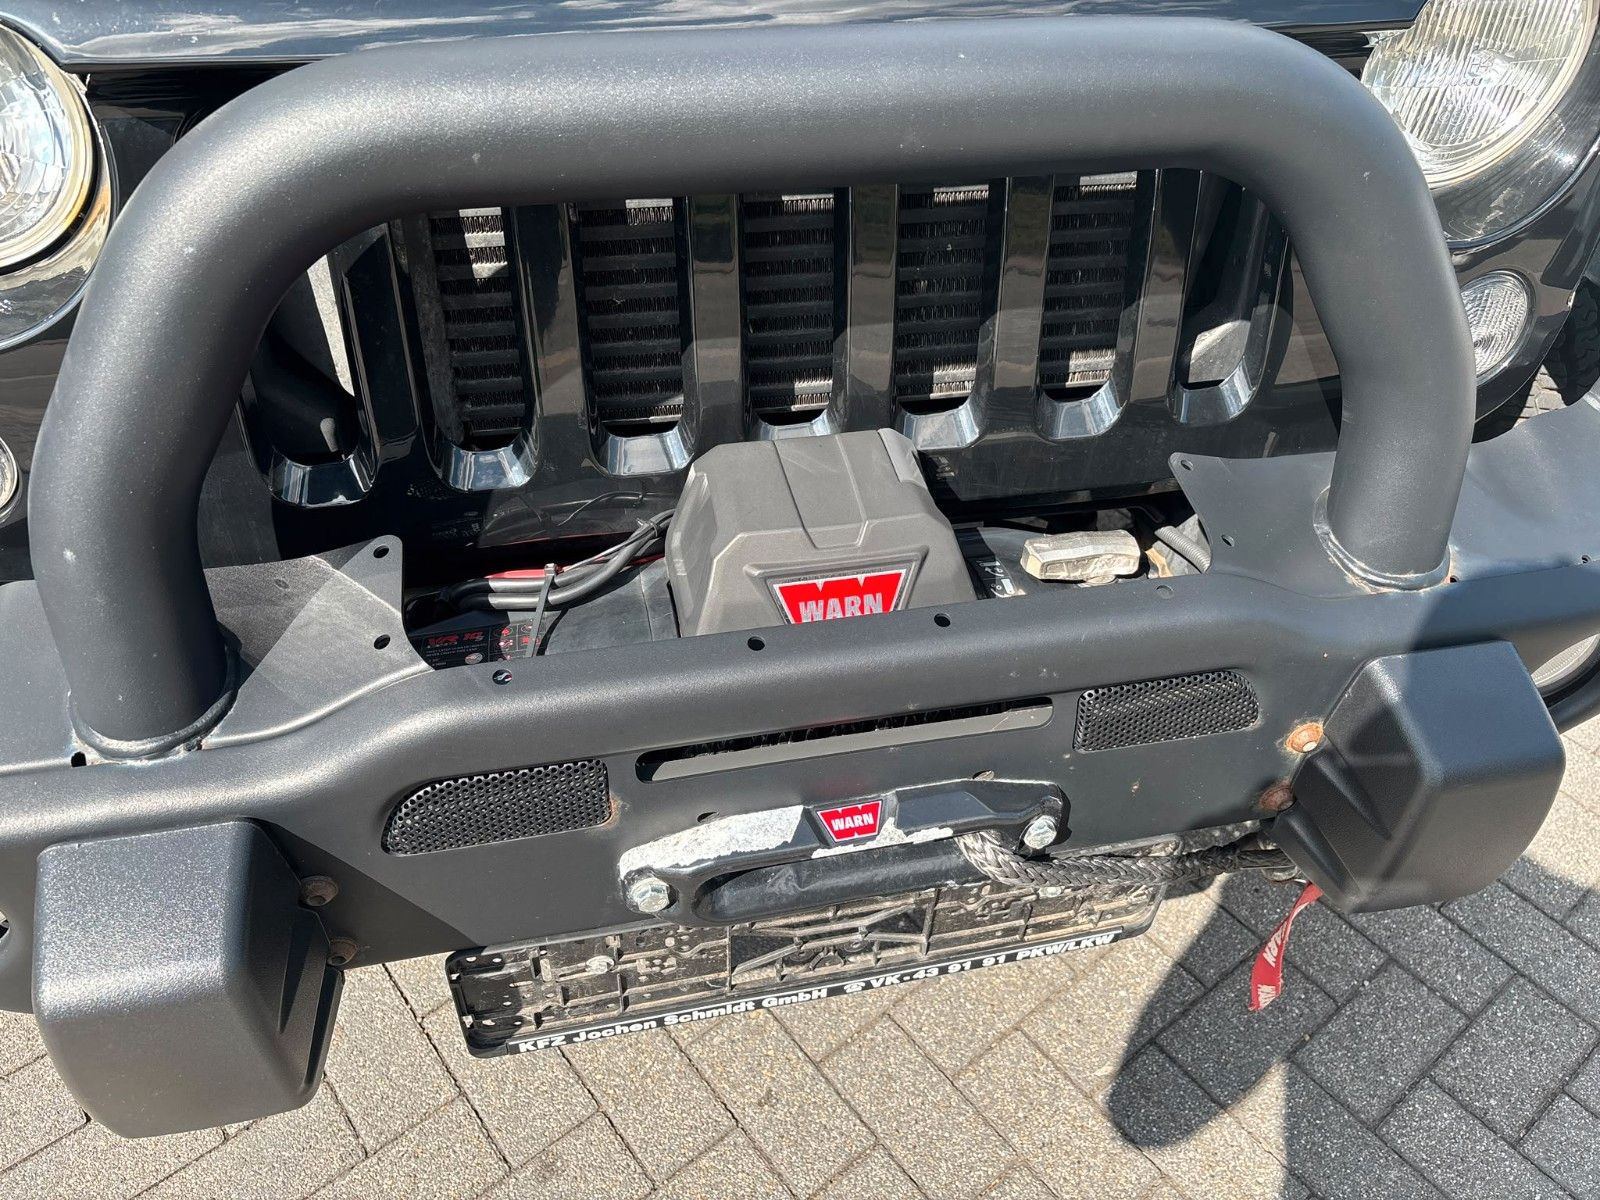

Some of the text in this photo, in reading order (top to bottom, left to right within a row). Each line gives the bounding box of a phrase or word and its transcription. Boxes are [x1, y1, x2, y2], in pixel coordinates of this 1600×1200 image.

[799, 592, 883, 623] WARN
[831, 812, 875, 831] WARN
[518, 1035, 567, 1053] KFZ
[572, 1020, 657, 1042] Jochen
[663, 1001, 756, 1026] Schmidt
[761, 988, 828, 1008] GmbH
[947, 961, 972, 973] 91
[981, 954, 1007, 967] 91
